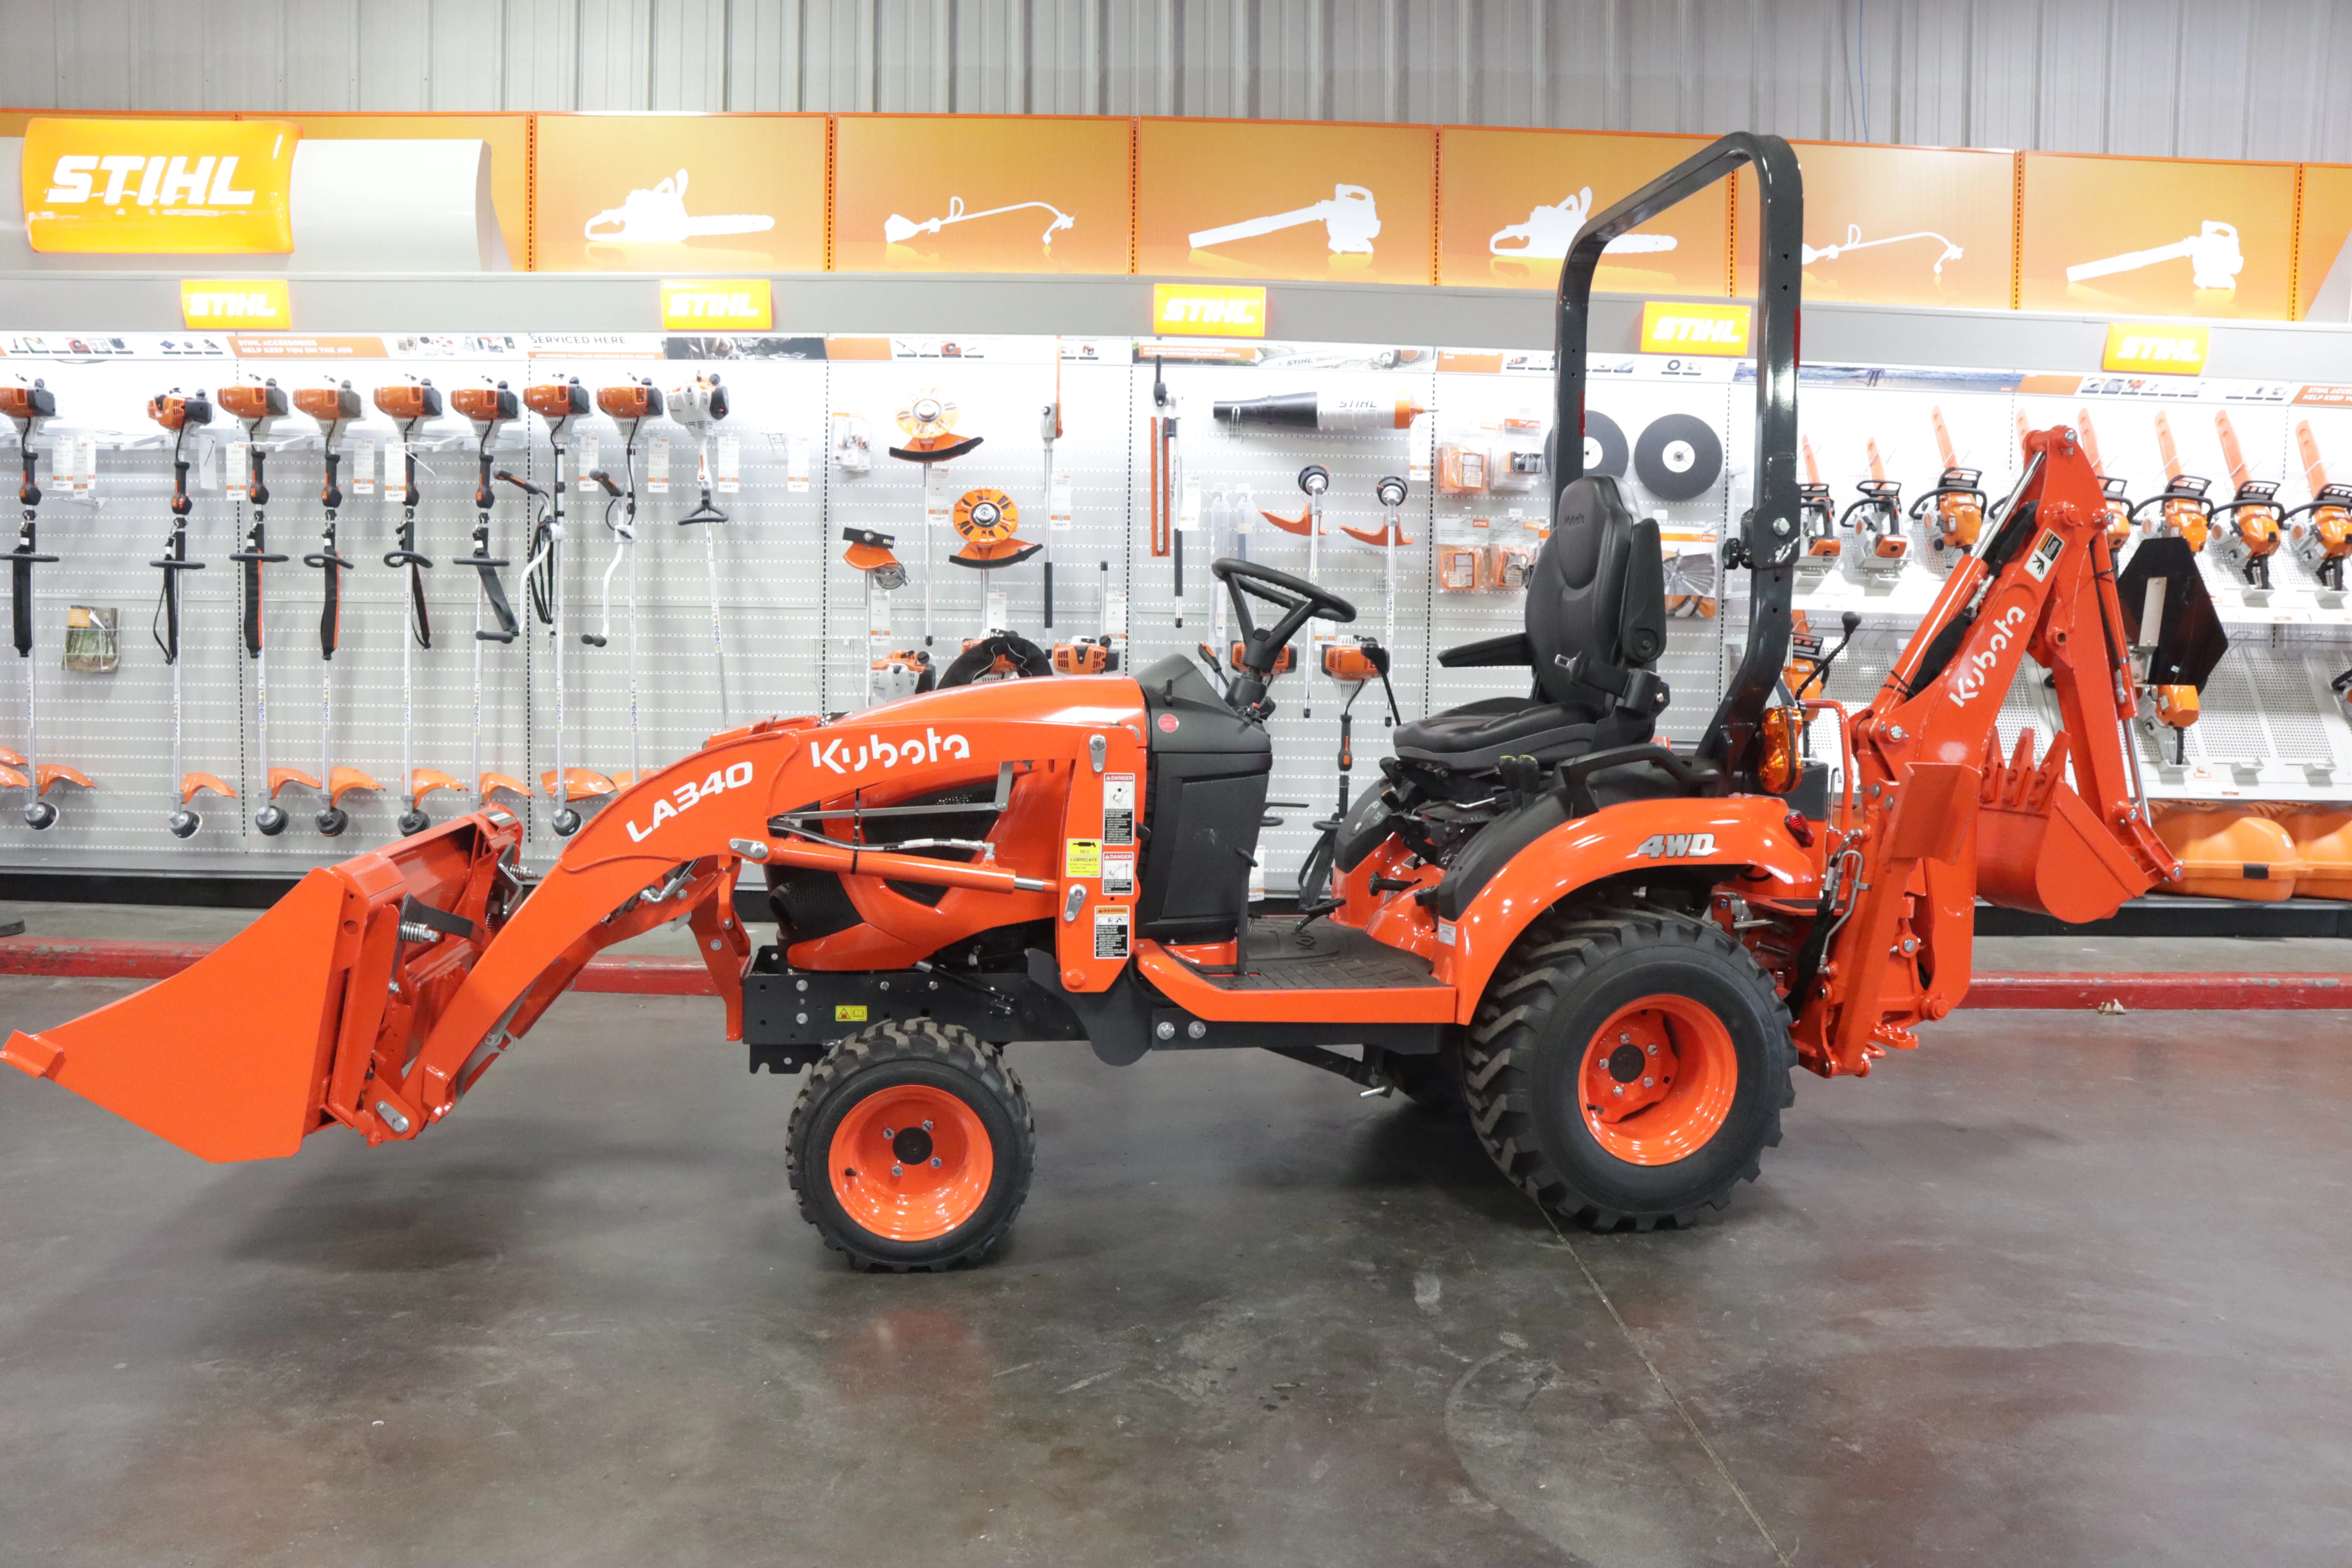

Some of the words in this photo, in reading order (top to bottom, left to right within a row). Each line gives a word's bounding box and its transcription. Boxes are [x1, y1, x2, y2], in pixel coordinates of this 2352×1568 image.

[44, 155, 254, 205] STIHL
[188, 294, 276, 316] STIHL
[668, 294, 759, 316] STIHL
[1163, 298, 1255, 323] STIHL
[1653, 318, 1740, 342] STIHL
[2117, 336, 2201, 361] STIHL
[1339, 399, 1377, 408] STIHL
[1949, 606, 2026, 708] Kubota
[811, 728, 970, 774] Kubota
[626, 761, 753, 842] LA340
[1636, 833, 1715, 858] 4WD
